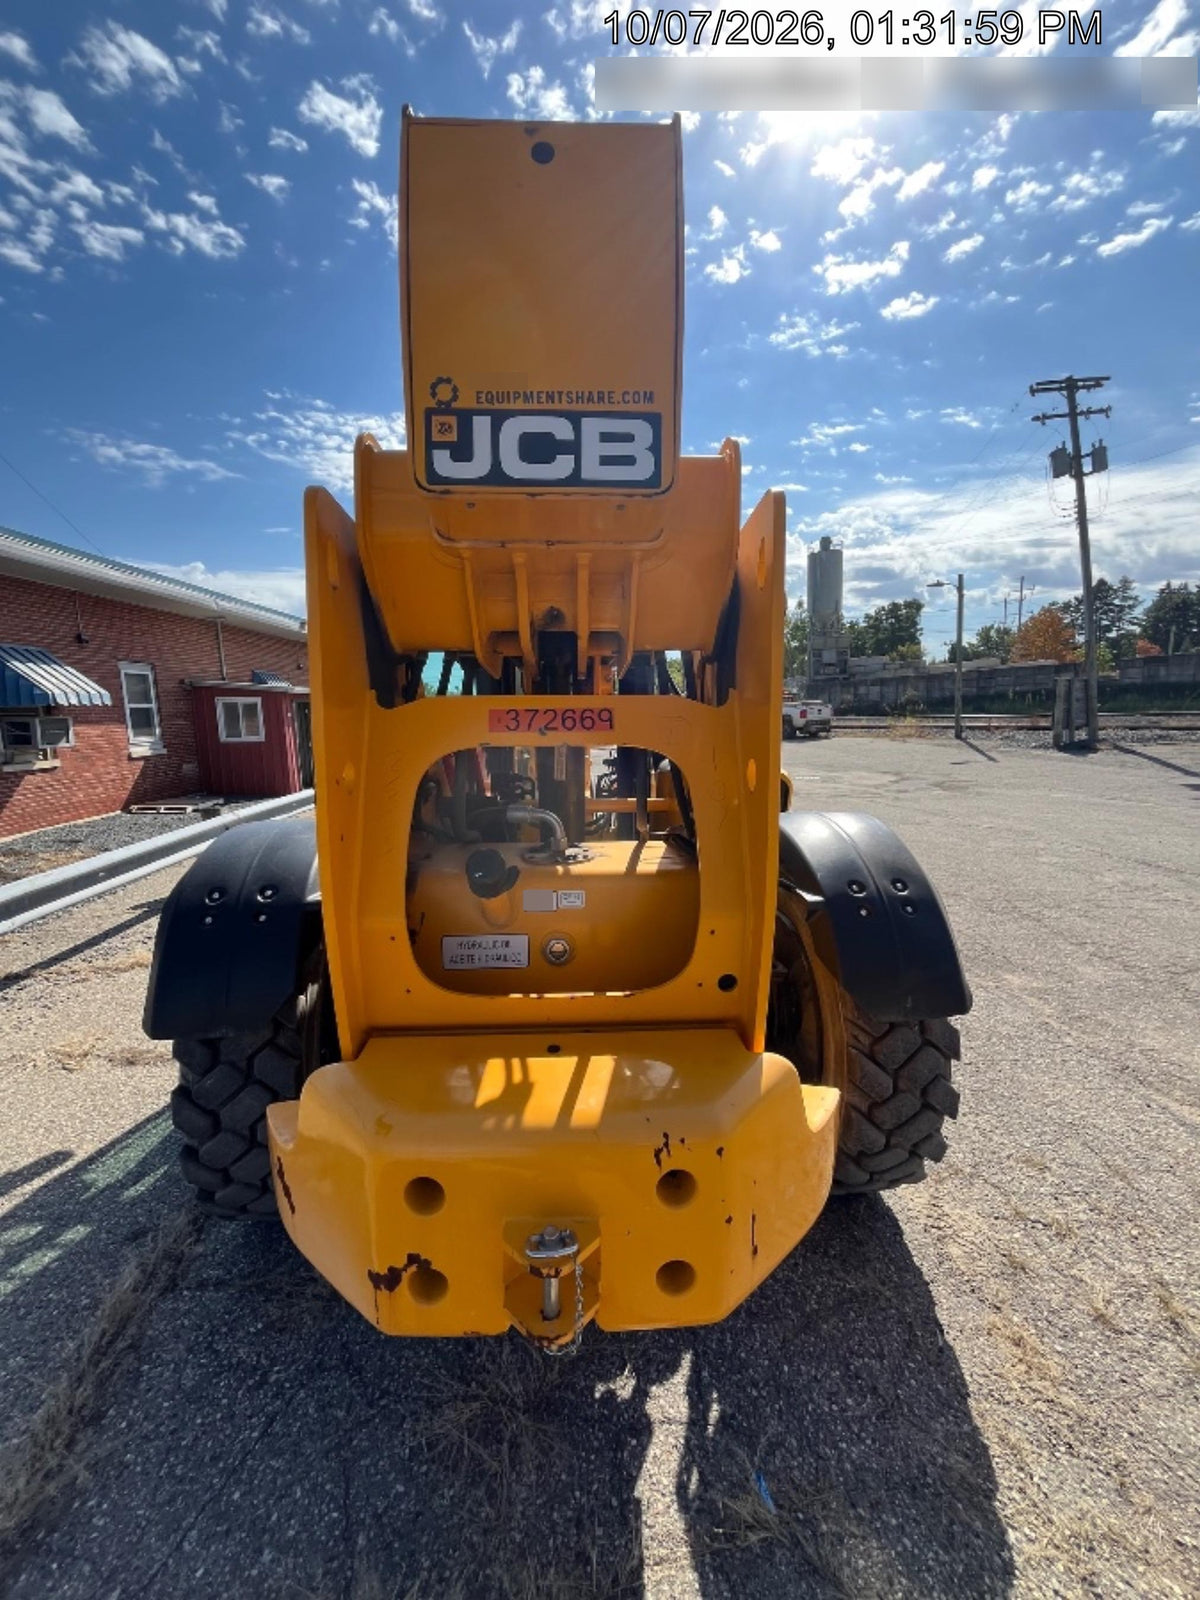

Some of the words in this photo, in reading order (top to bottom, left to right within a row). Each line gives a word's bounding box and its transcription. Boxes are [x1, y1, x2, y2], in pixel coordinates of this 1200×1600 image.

[475, 389, 655, 405] EQUIPMENTSHARE.COM
[431, 415, 656, 481] JCB
[505, 708, 614, 732] 372669
